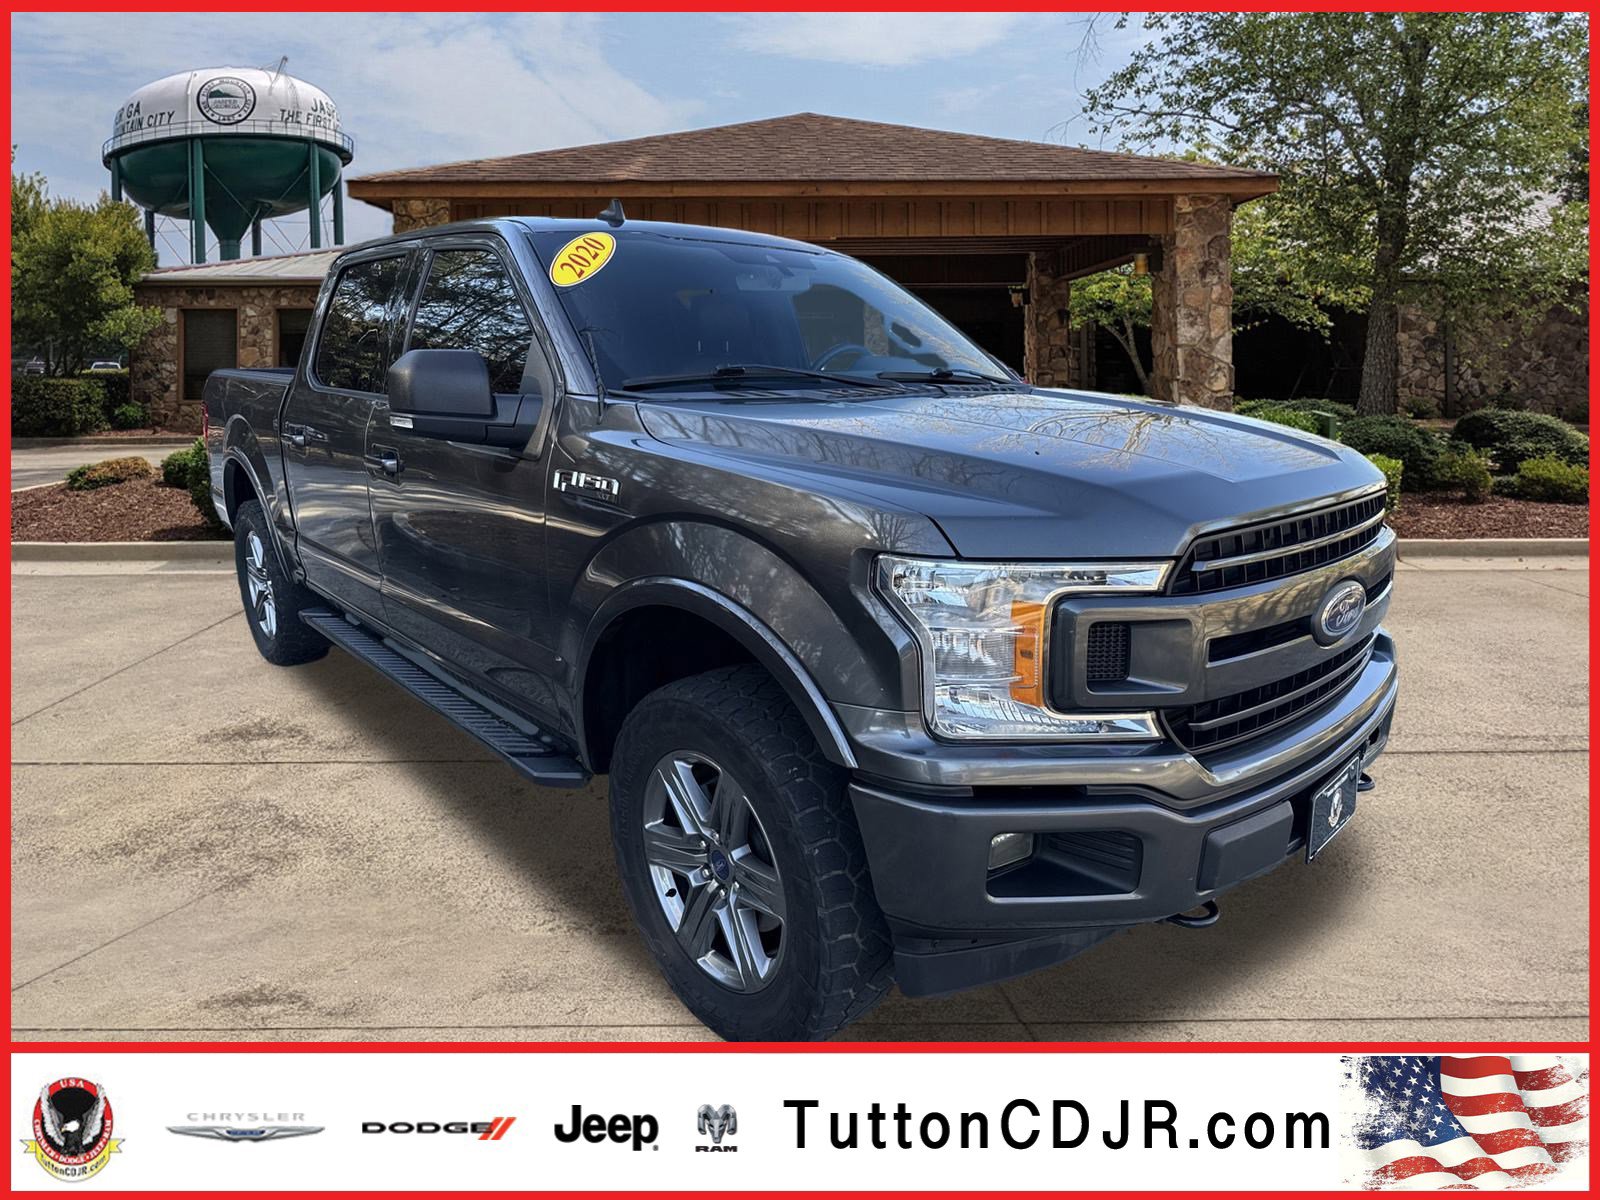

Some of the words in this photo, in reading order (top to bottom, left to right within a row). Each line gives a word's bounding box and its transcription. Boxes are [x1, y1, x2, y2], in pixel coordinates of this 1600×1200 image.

[126, 100, 141, 119] GA
[147, 110, 176, 127] CITY
[280, 108, 302, 124] THE
[306, 112, 332, 129] FIRST
[560, 237, 606, 279] 2020
[1329, 598, 1360, 627] Ford
